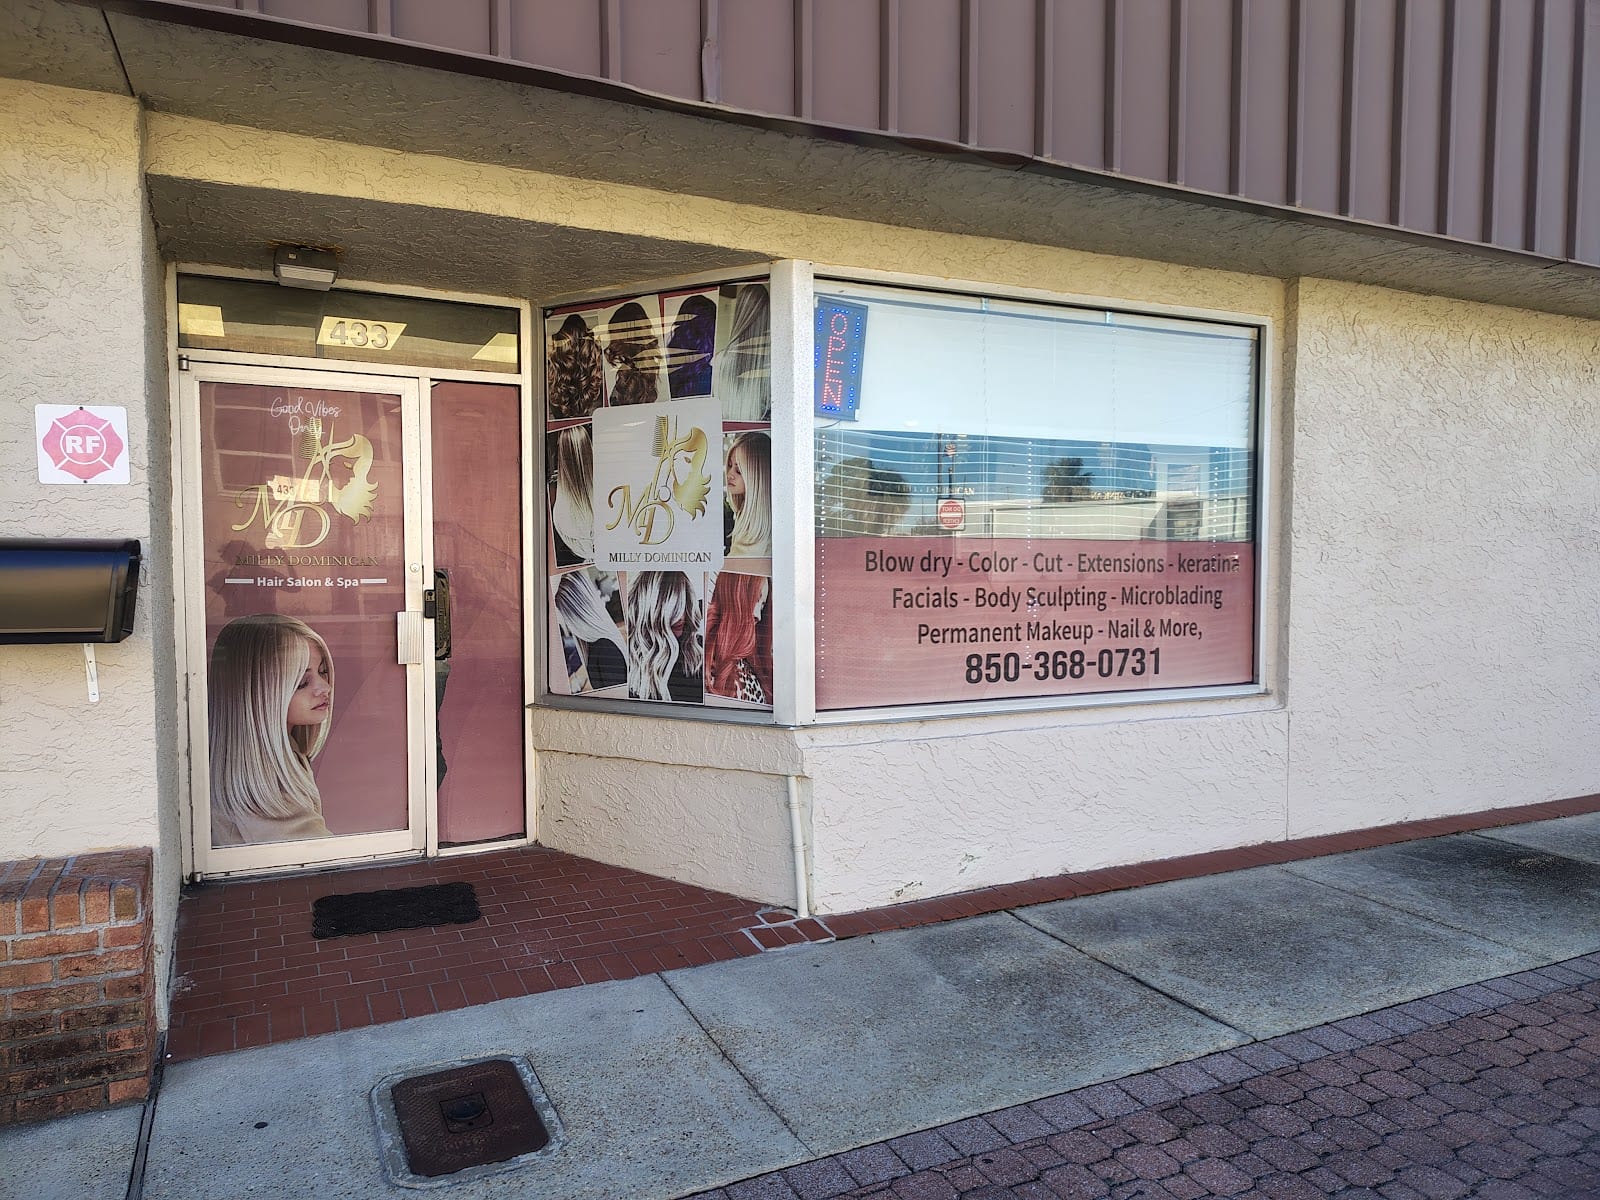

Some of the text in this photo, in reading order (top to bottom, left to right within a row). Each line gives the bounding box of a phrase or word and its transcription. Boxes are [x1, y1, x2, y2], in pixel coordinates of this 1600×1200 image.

[329, 320, 389, 349] 433
[823, 312, 848, 407] OPEN
[270, 396, 342, 418] Good Vibes
[65, 435, 101, 454] RF
[235, 555, 379, 567] MILLY DOMINICAN
[608, 552, 712, 563] MILLY DOMINICAN
[865, 549, 915, 573] Blow
[919, 549, 953, 578] dry
[968, 550, 1019, 573] Color
[1033, 552, 1064, 573] Cut
[1077, 552, 1165, 573] Extensions
[257, 576, 359, 588] Hair Salon & Spa
[892, 586, 959, 609] Facials
[975, 586, 1022, 613] Body
[1025, 585, 1108, 612] Sculpting
[1120, 585, 1223, 610] Microblading
[917, 622, 1023, 645] Permanent
[1026, 619, 1094, 646] Makeup
[1108, 617, 1140, 640] Nail
[1143, 618, 1156, 639] &
[1159, 618, 1203, 641] More,
[965, 647, 1161, 684] 850-368-0731
